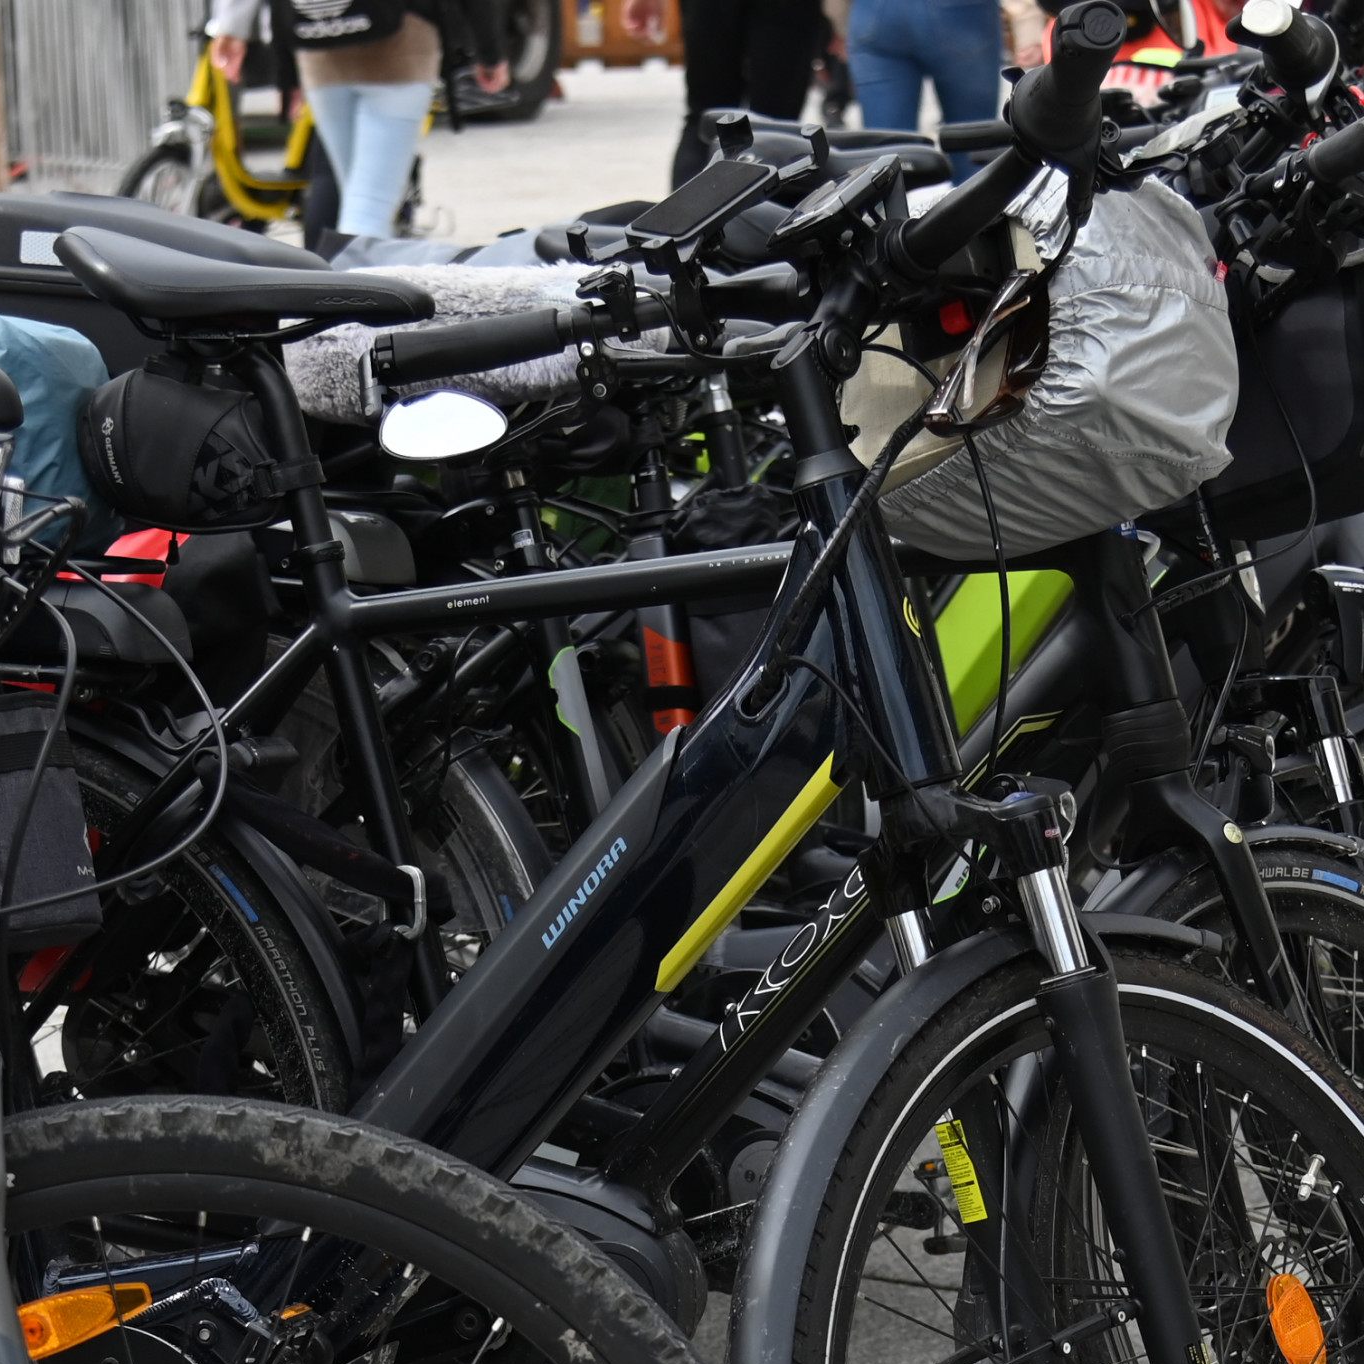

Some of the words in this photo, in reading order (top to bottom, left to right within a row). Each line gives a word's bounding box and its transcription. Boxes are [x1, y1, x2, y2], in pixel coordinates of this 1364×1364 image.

[105, 436, 124, 486] GERMANY
[447, 595, 489, 609] element
[541, 837, 627, 950] WINORA
[1257, 866, 1310, 880] HWALBE
[254, 925, 309, 1017] MARATHON
[303, 1025, 326, 1071] PLUS
